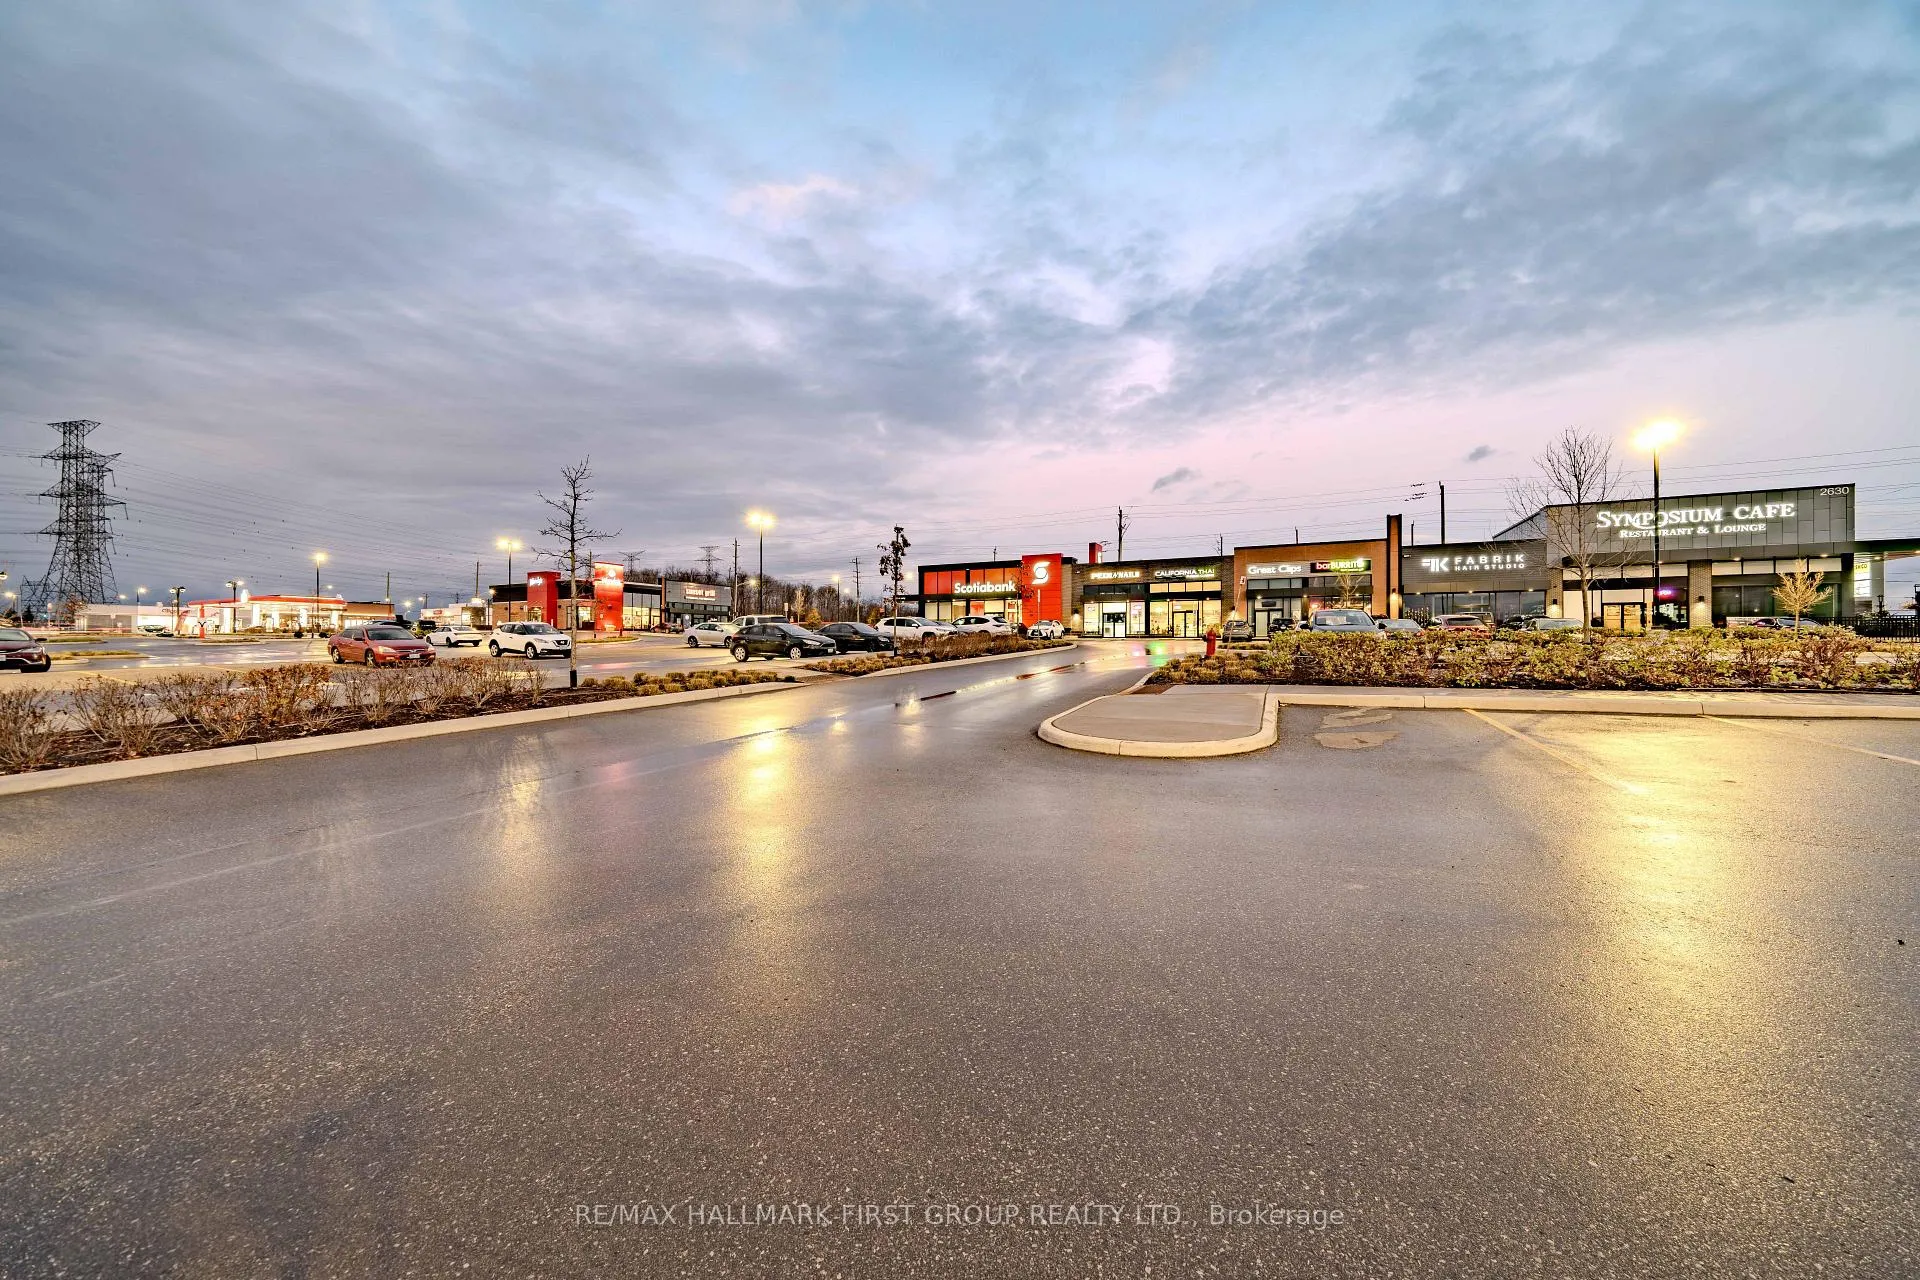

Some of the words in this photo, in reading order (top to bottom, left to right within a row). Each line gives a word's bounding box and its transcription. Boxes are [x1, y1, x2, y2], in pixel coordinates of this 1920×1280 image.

[1820, 487, 1849, 495] 2630
[1597, 508, 1723, 530] SYMPOSIUM
[1733, 504, 1796, 520] CAFE
[1696, 526, 1710, 534] &
[1713, 523, 1767, 534] LOUNGE
[1454, 554, 1525, 565] FABRIK
[1248, 565, 1277, 574] Great
[1277, 564, 1303, 574] Clips
[1484, 562, 1525, 570] STUDIO
[1155, 569, 1197, 577] CALIFORNIA
[954, 580, 1017, 594] Scotiabank
